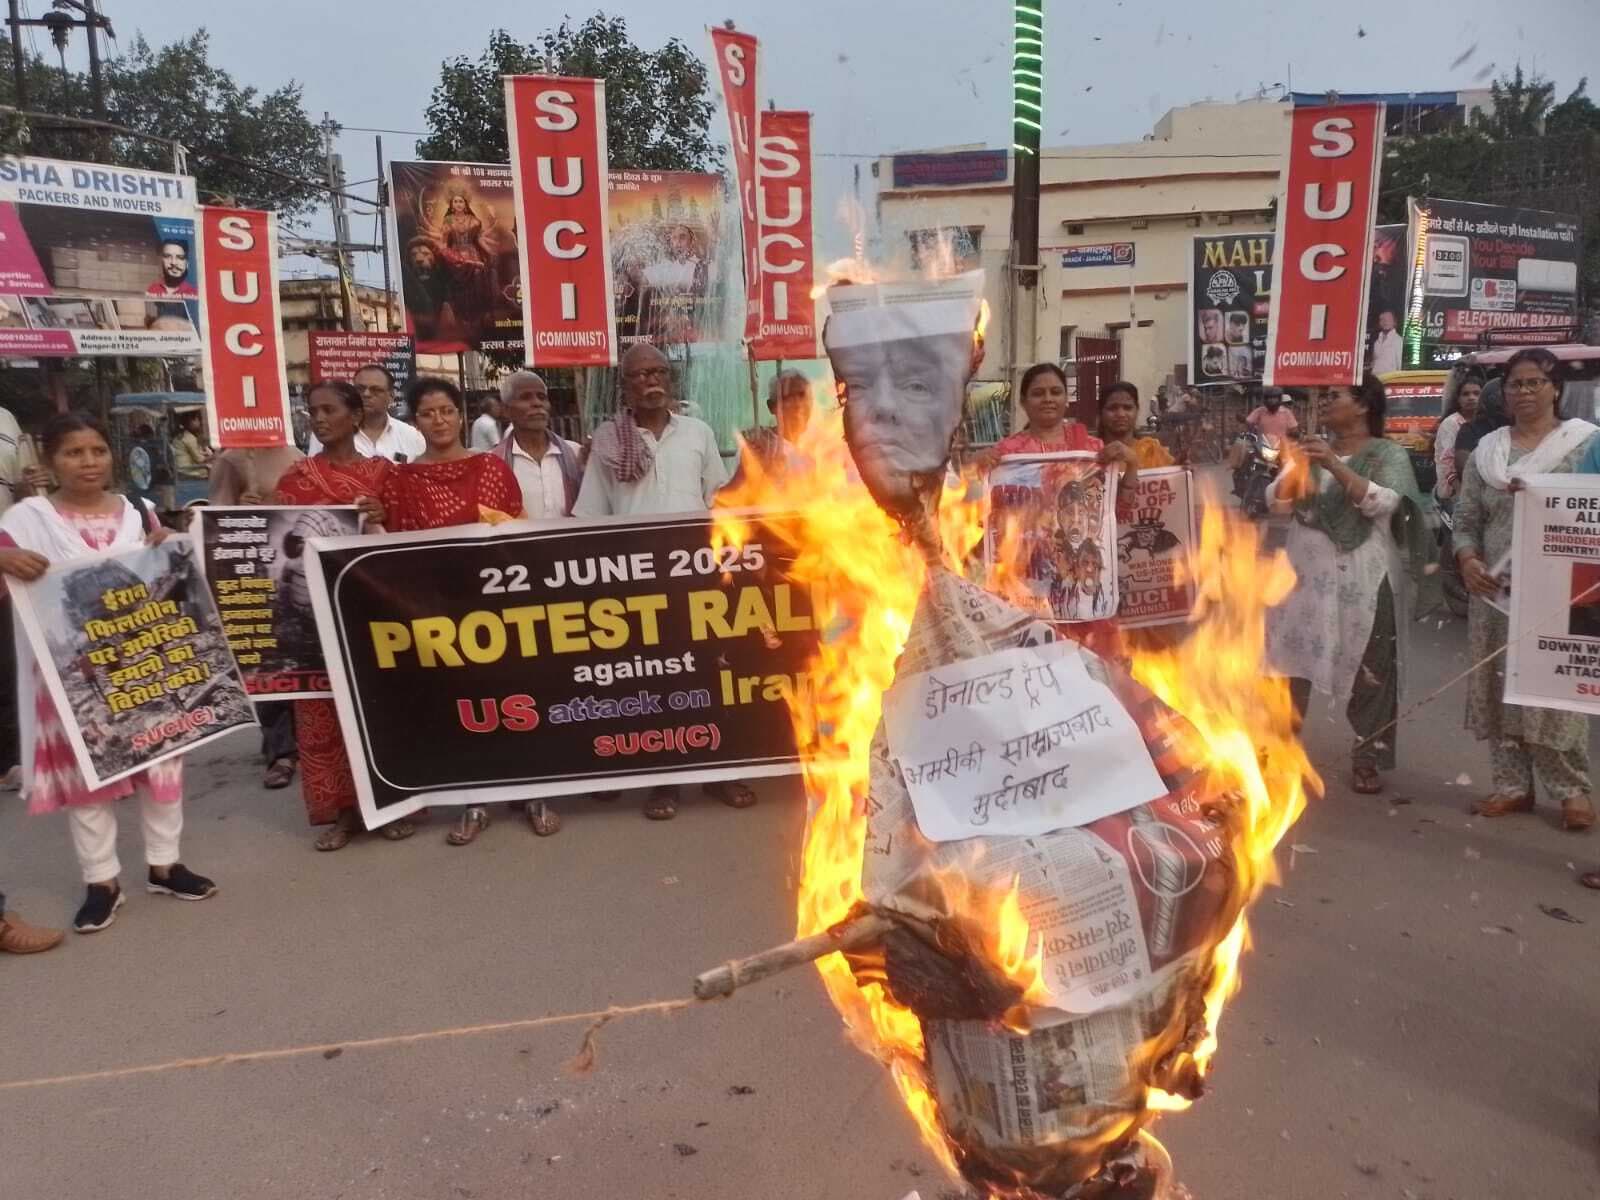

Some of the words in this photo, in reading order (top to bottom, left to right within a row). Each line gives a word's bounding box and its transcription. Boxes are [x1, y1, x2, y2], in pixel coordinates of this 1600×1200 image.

[72, 167, 184, 200] DRISHTI
[18, 187, 80, 206] PACKERS
[83, 195, 110, 209] AND
[113, 197, 163, 213] MOVERS
[535, 90, 588, 322] SUCI
[760, 136, 805, 320] SUCI
[1299, 117, 1354, 341] SUCI
[1518, 224, 1559, 241] Installation
[1201, 238, 1273, 268] MAH
[217, 215, 264, 408] SUCI
[1426, 311, 1445, 327] LG
[1457, 311, 1530, 328] ELECTRONIC
[536, 330, 607, 352] (COMMUNIST)
[761, 324, 813, 340] OMMUNIST)
[1278, 350, 1352, 370] (COMMUNIST)
[220, 415, 283, 434] (COMMUNIST)
[1147, 492, 1177, 507] OFF
[1545, 496, 1561, 509] IF
[1566, 497, 1600, 510] GRE
[1543, 524, 1600, 536] IMPERIAL
[479, 564, 532, 595] 22
[543, 552, 657, 589] JUNE
[668, 543, 766, 578] 2025
[102, 582, 149, 612] ईरान
[1125, 586, 1169, 607] UCI
[84, 600, 179, 642] फिलस्तीन
[368, 593, 669, 670] PROTEST
[87, 646, 119, 666] पर
[121, 616, 199, 658] अमेरिकी
[165, 643, 195, 665] का
[1538, 639, 1582, 653] DOWN
[573, 650, 697, 687] against
[1554, 664, 1600, 679] ATTAC
[1568, 653, 1600, 667] IMP
[106, 681, 166, 715] विरोध
[308, 675, 331, 692] (C
[924, 667, 1015, 720] डोनाल्ड
[1576, 682, 1600, 697] SU
[456, 693, 540, 734] US
[548, 689, 663, 725] attack
[668, 687, 712, 710] on
[131, 704, 217, 752] SUCI(C)
[593, 721, 722, 758] SUCI(C)
[905, 740, 986, 786] अमरीकी
[969, 763, 1071, 827] मुर्दाबाद
